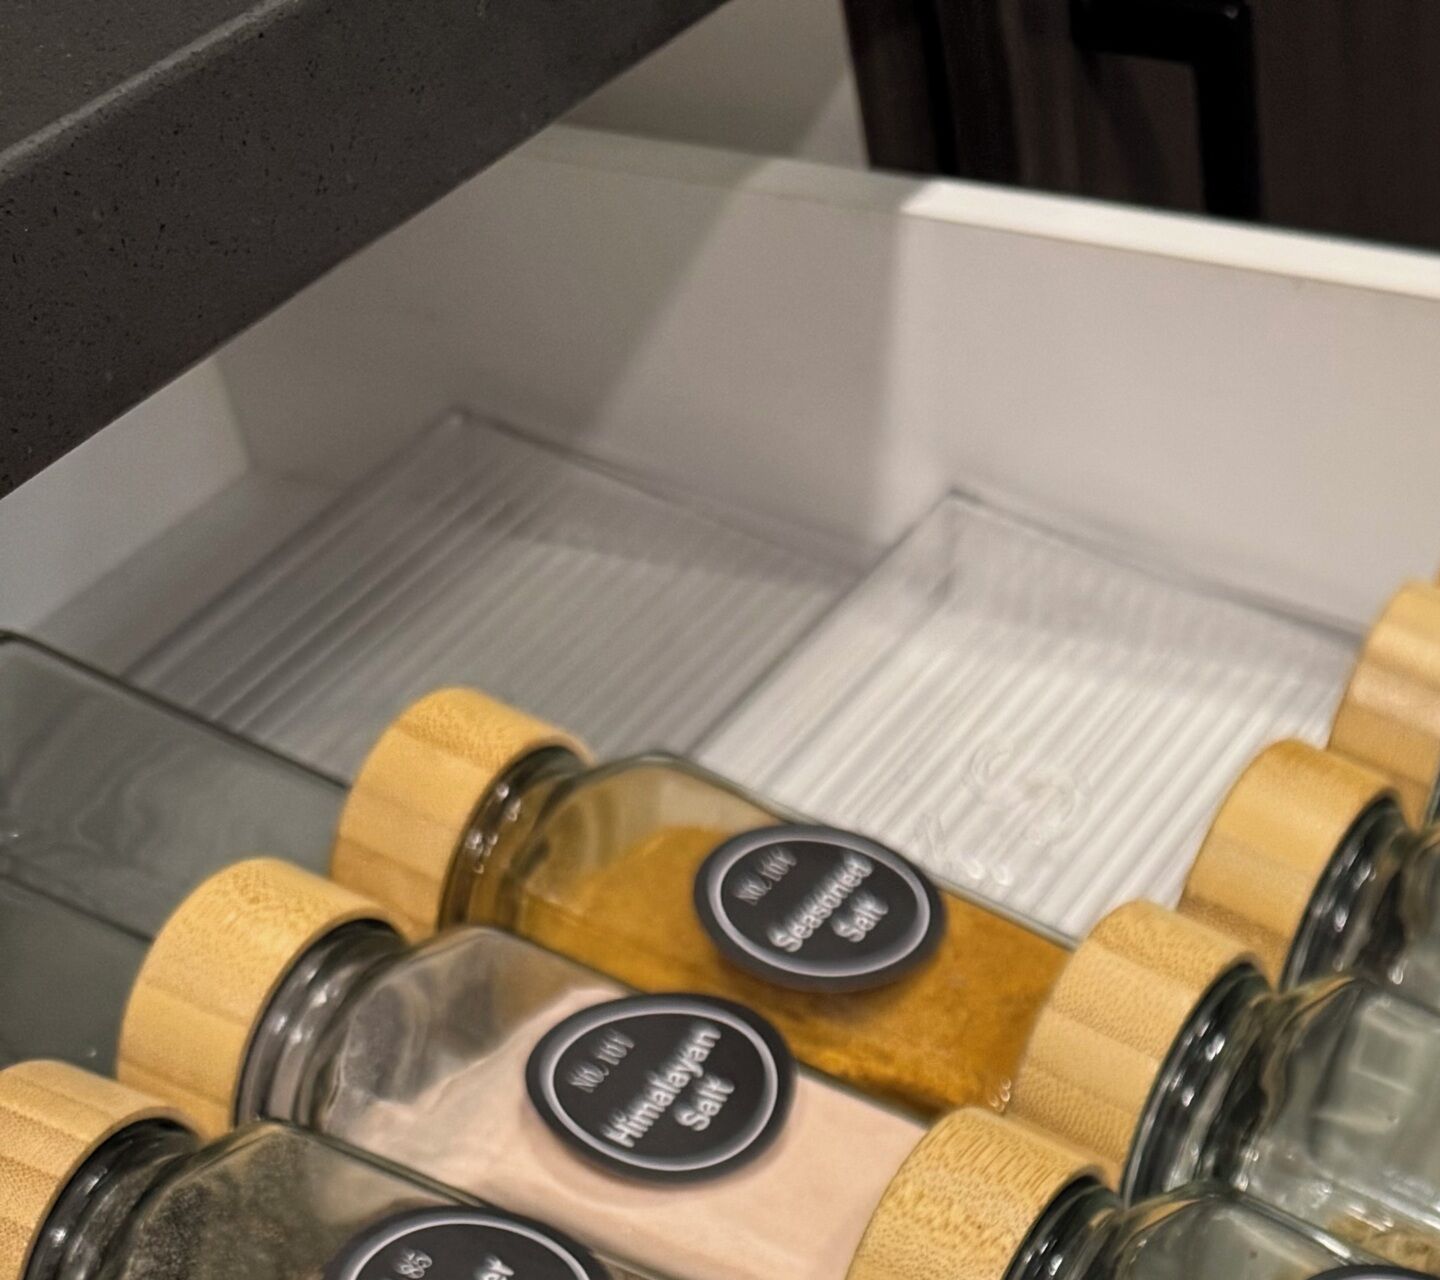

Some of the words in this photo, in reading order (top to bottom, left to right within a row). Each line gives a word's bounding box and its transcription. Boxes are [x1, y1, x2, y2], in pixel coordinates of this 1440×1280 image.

[768, 854, 873, 953] Seasoned
[832, 894, 889, 943] Salt
[603, 1026, 721, 1148] Himalayan
[674, 1075, 735, 1132] Salt
[397, 1251, 433, 1279] 85
